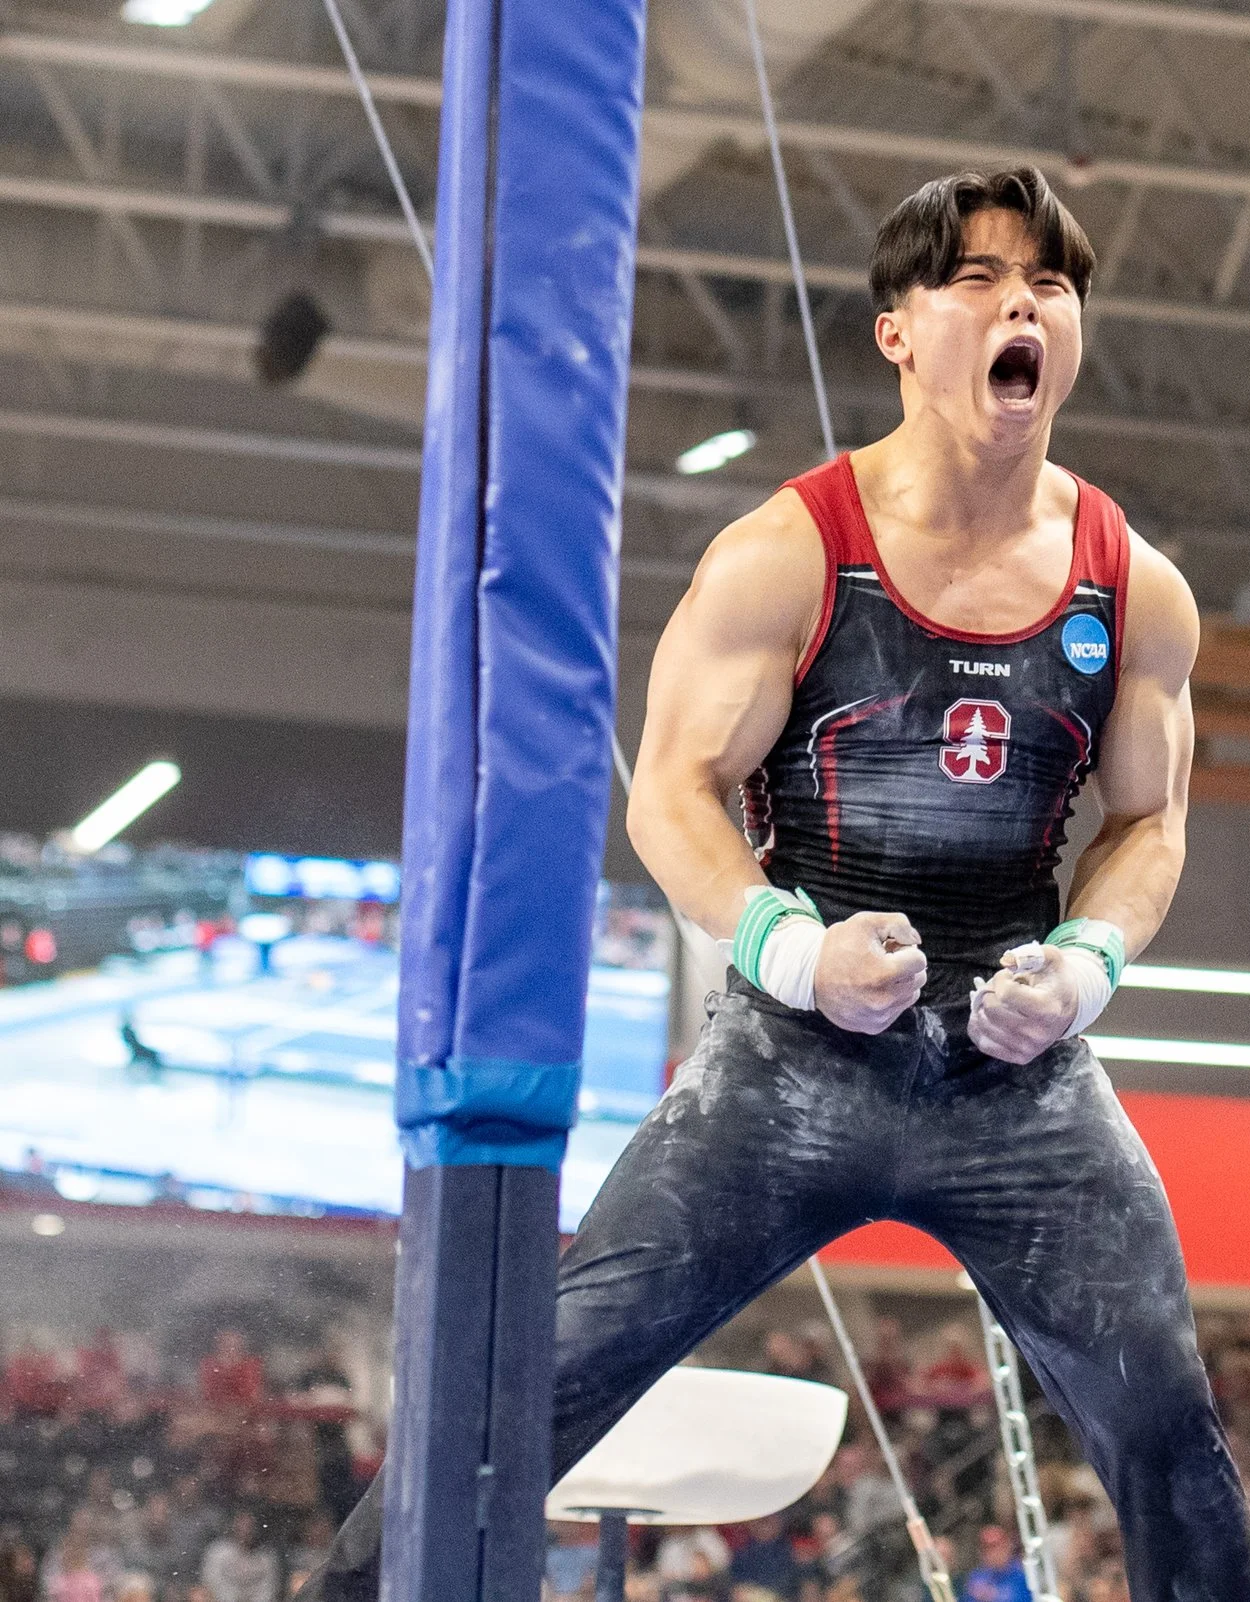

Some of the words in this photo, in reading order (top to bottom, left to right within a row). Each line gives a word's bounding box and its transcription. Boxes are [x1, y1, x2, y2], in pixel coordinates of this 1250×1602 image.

[1070, 642, 1107, 659] NCAA
[949, 660, 1010, 677] TURN
[939, 698, 1011, 784] S
